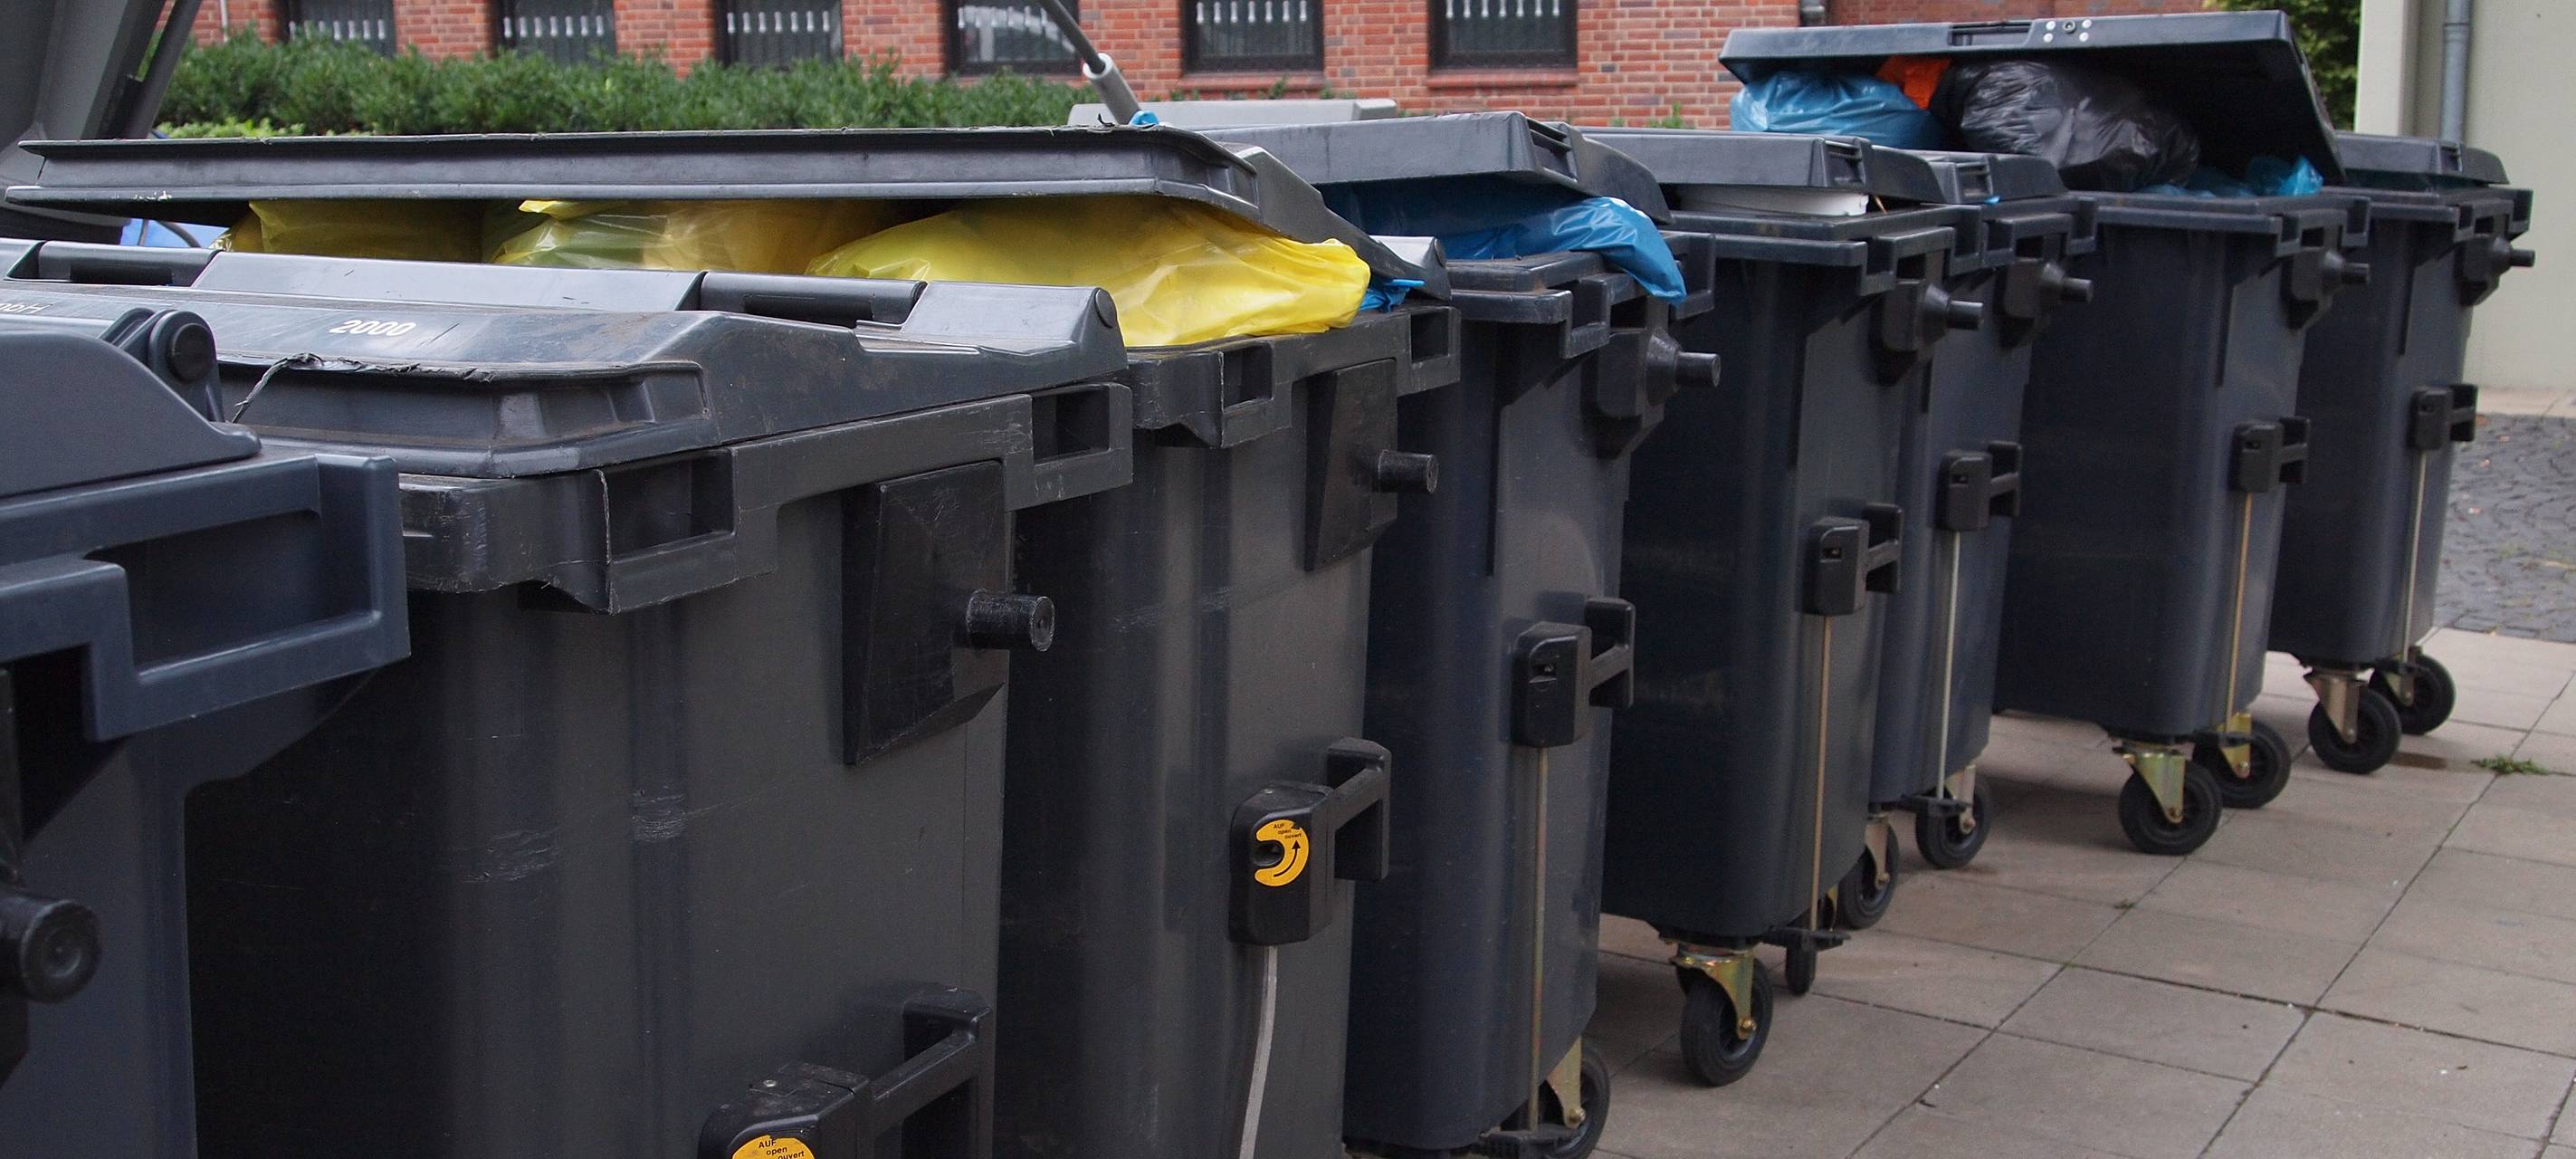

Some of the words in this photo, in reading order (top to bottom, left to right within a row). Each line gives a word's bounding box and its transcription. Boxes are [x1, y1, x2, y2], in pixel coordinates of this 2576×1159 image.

[329, 320, 416, 336] 2000
[758, 1139, 777, 1148] AUF
[766, 1147, 787, 1156] open
